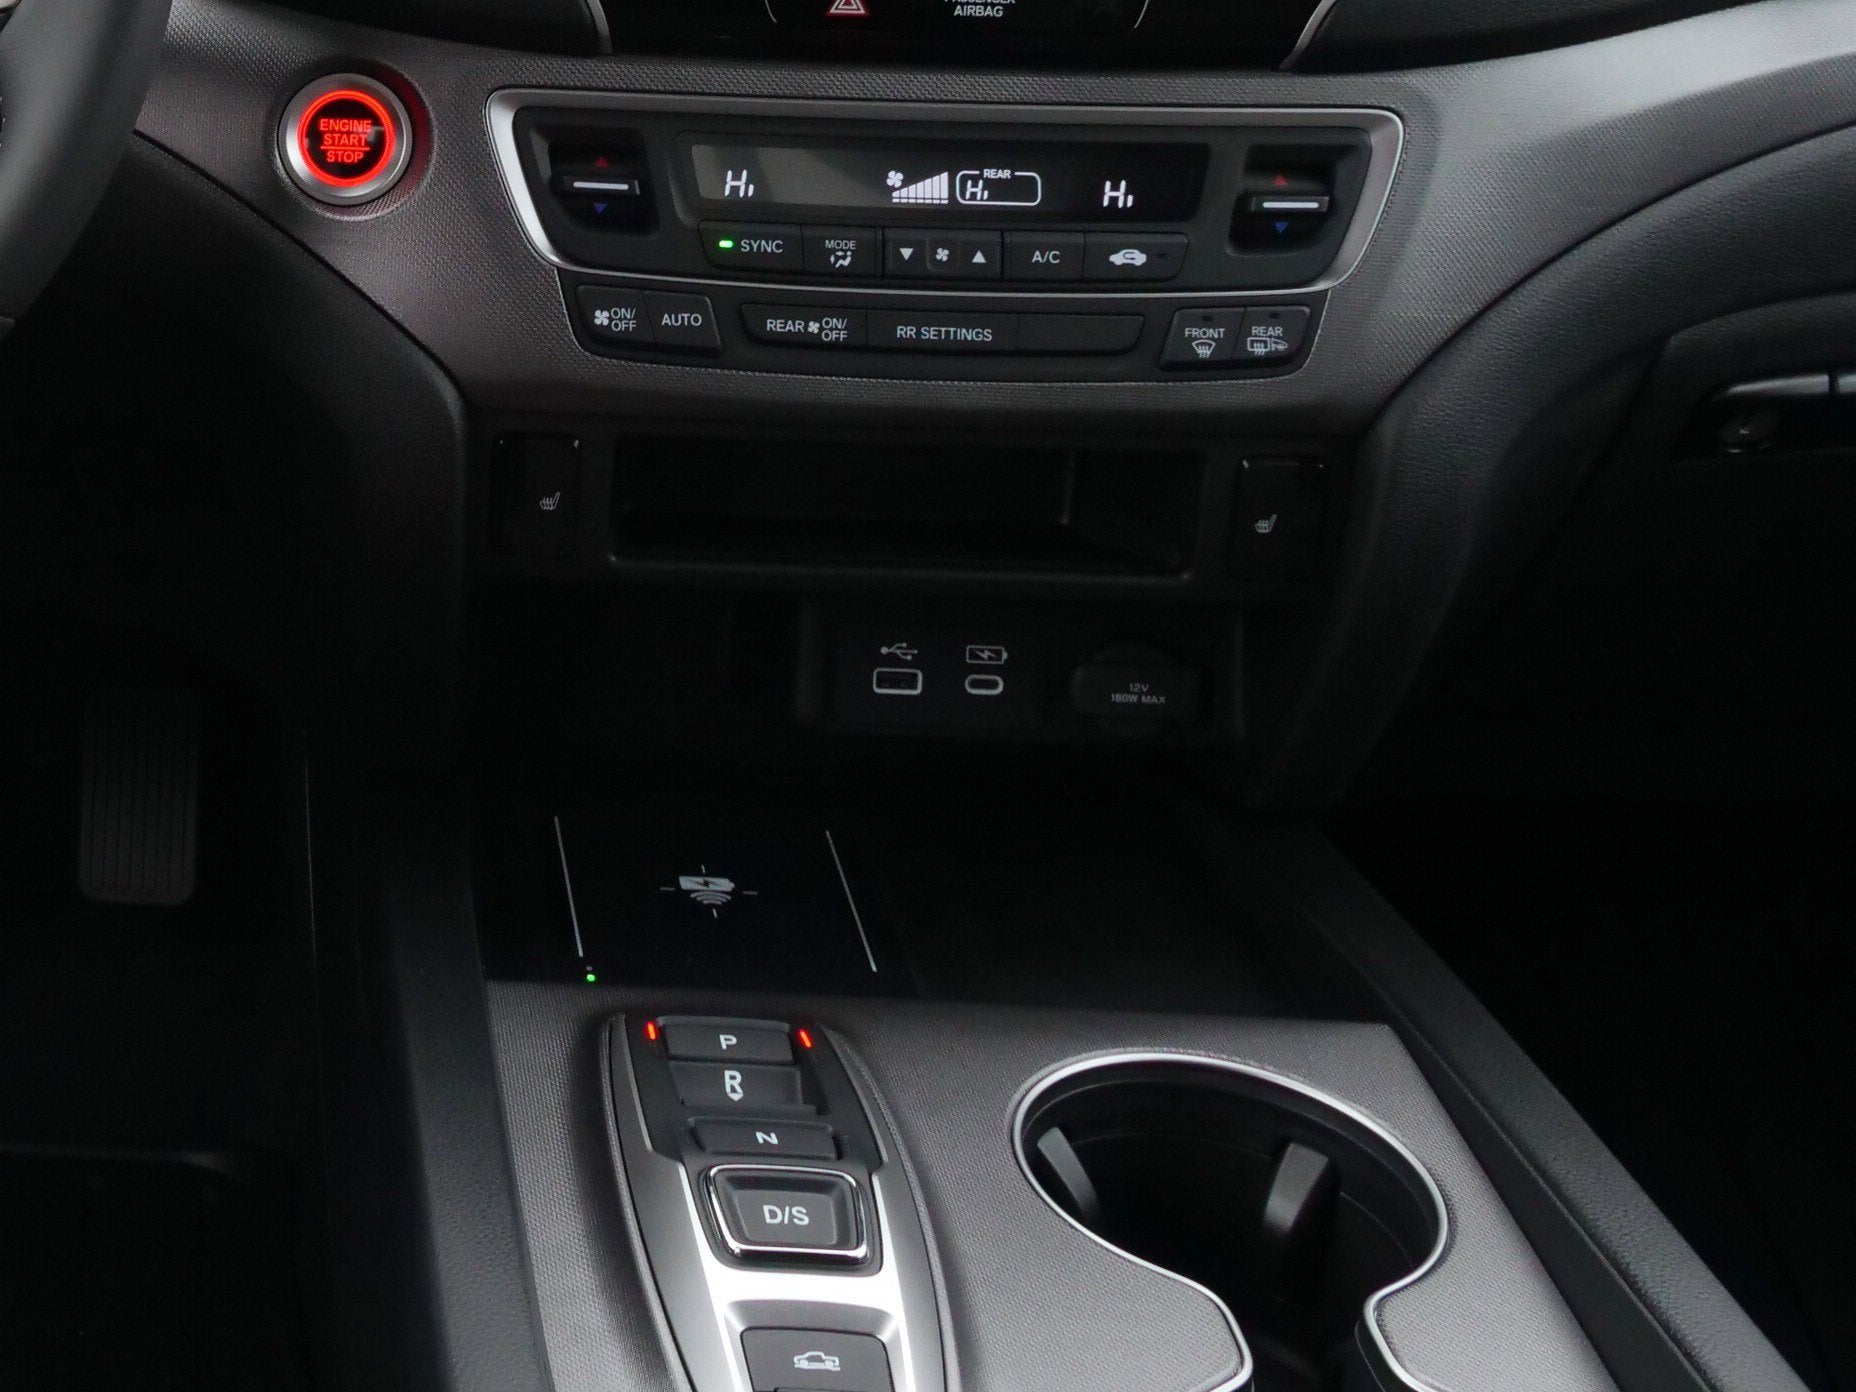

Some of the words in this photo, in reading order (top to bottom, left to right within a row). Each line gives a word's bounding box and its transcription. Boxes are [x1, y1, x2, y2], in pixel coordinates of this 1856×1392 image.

[954, 4, 1003, 18] AIRBAG
[320, 119, 372, 133] ENGINE
[324, 133, 368, 146] START
[326, 151, 364, 163] STOP
[983, 169, 1011, 179] REAR
[741, 239, 783, 253] SYNC
[825, 240, 856, 250] MODE
[1032, 250, 1061, 264] A/C
[611, 307, 636, 319] ON/
[661, 313, 702, 326] AUTO
[611, 320, 636, 331] OFF
[766, 319, 804, 332] REAR
[822, 317, 848, 330] ON/
[822, 329, 848, 342] OFF
[897, 326, 916, 339] RR
[920, 326, 993, 342] SETTINGS
[1184, 327, 1226, 339] FRONT
[1251, 326, 1283, 337] REAR
[1129, 683, 1149, 693] 12V
[1111, 693, 1139, 703] 180W
[1141, 694, 1165, 705] MAX
[719, 1034, 738, 1050] P
[724, 1069, 743, 1094] R
[755, 1131, 779, 1145] N
[762, 1204, 810, 1226] D/S
